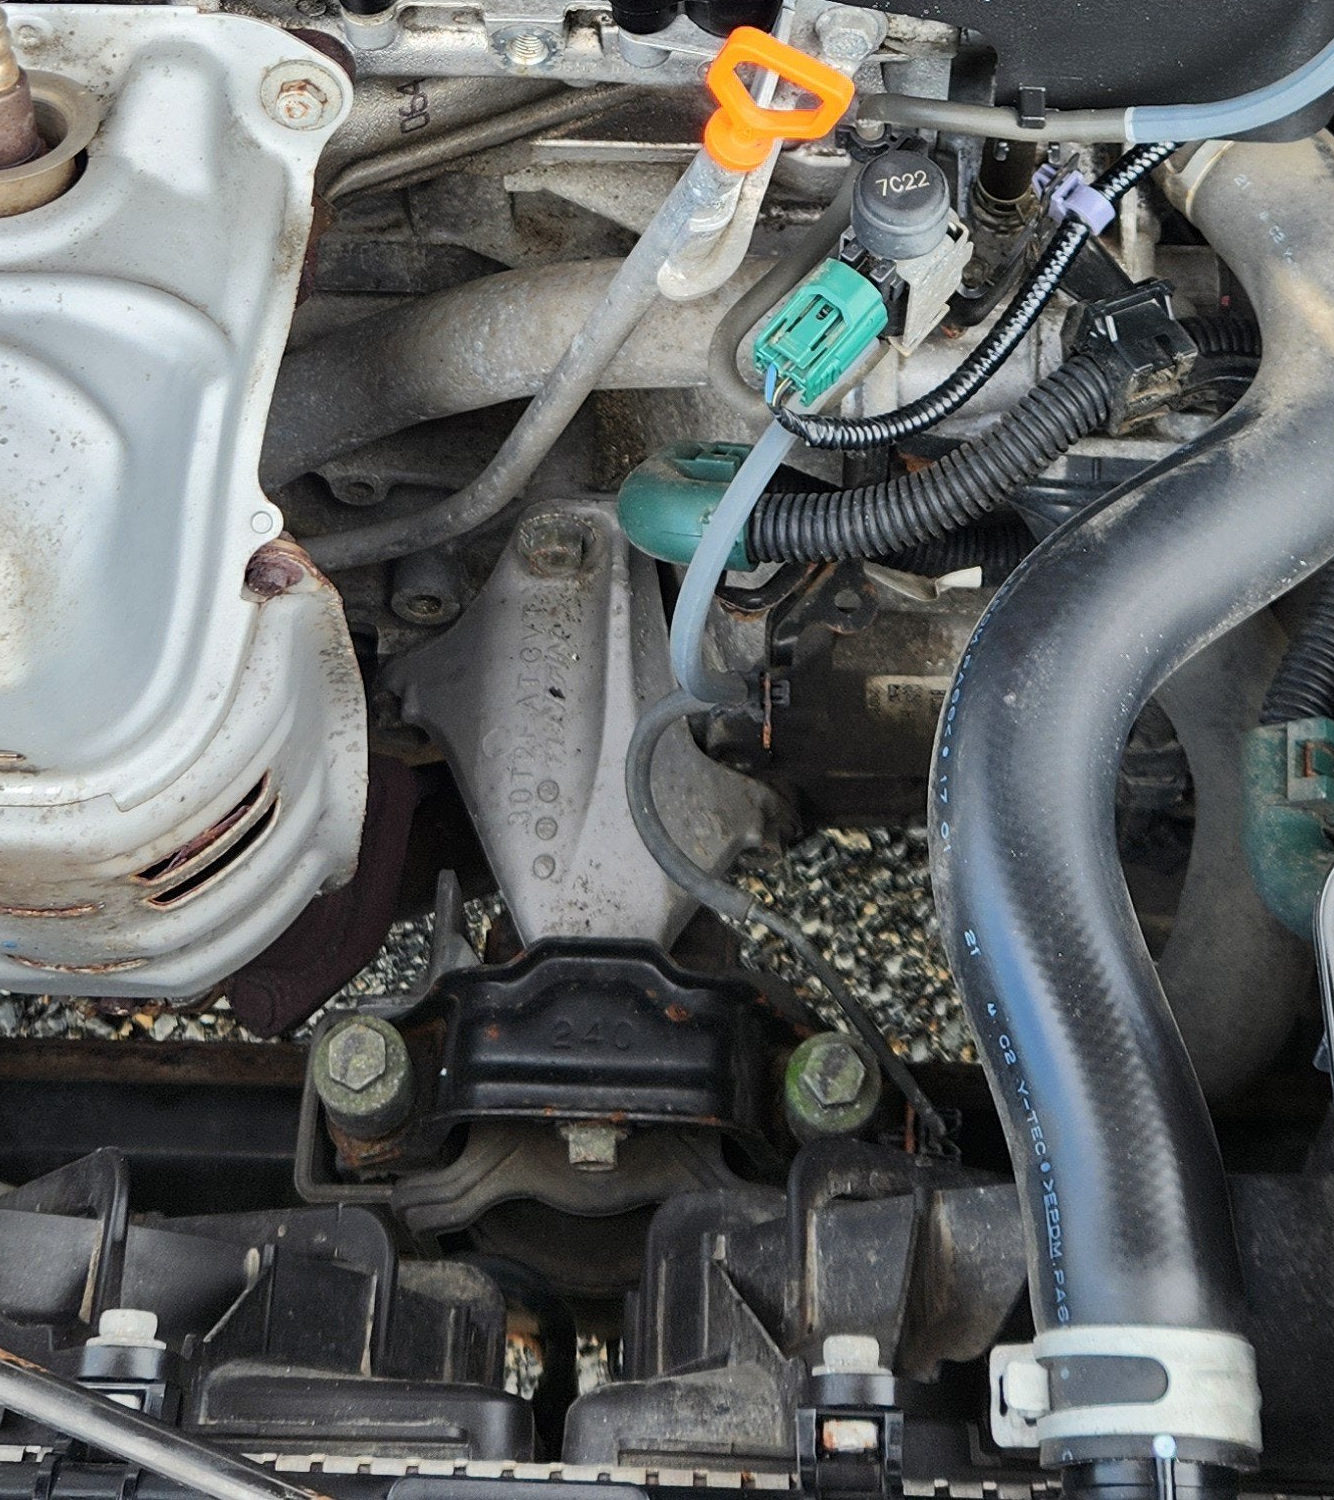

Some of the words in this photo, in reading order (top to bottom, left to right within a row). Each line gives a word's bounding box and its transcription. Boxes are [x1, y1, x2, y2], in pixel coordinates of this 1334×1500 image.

[875, 170, 931, 198] 7C22
[962, 928, 983, 958] 21
[997, 1032, 1018, 1066] C2
[1015, 1078, 1048, 1157] Y-TEC
